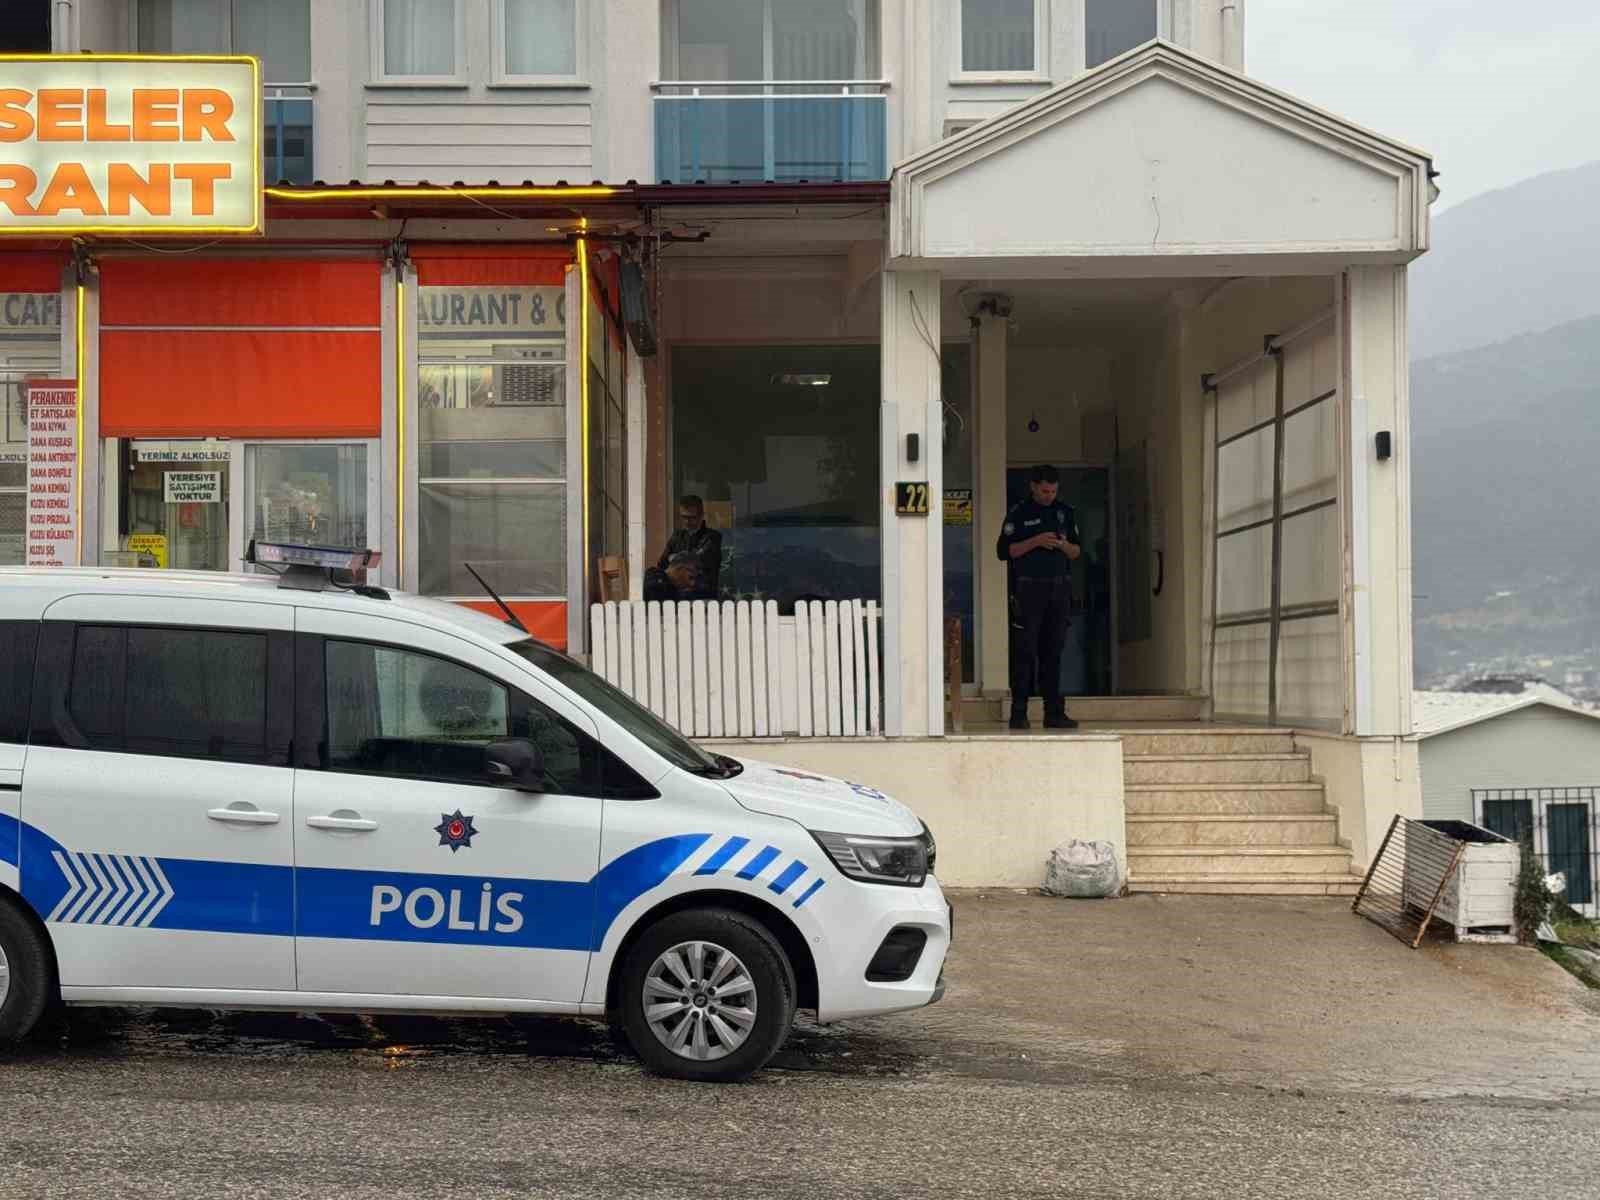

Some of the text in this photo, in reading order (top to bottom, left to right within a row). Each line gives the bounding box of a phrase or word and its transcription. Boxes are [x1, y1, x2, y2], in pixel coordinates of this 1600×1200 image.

[0, 88, 236, 143] SELER
[0, 162, 232, 216] RANT
[30, 391, 76, 405] PERAKENDE
[181, 452, 231, 460] ALKOLSUZ
[906, 485, 927, 512] 22
[370, 882, 524, 933] POLİS
